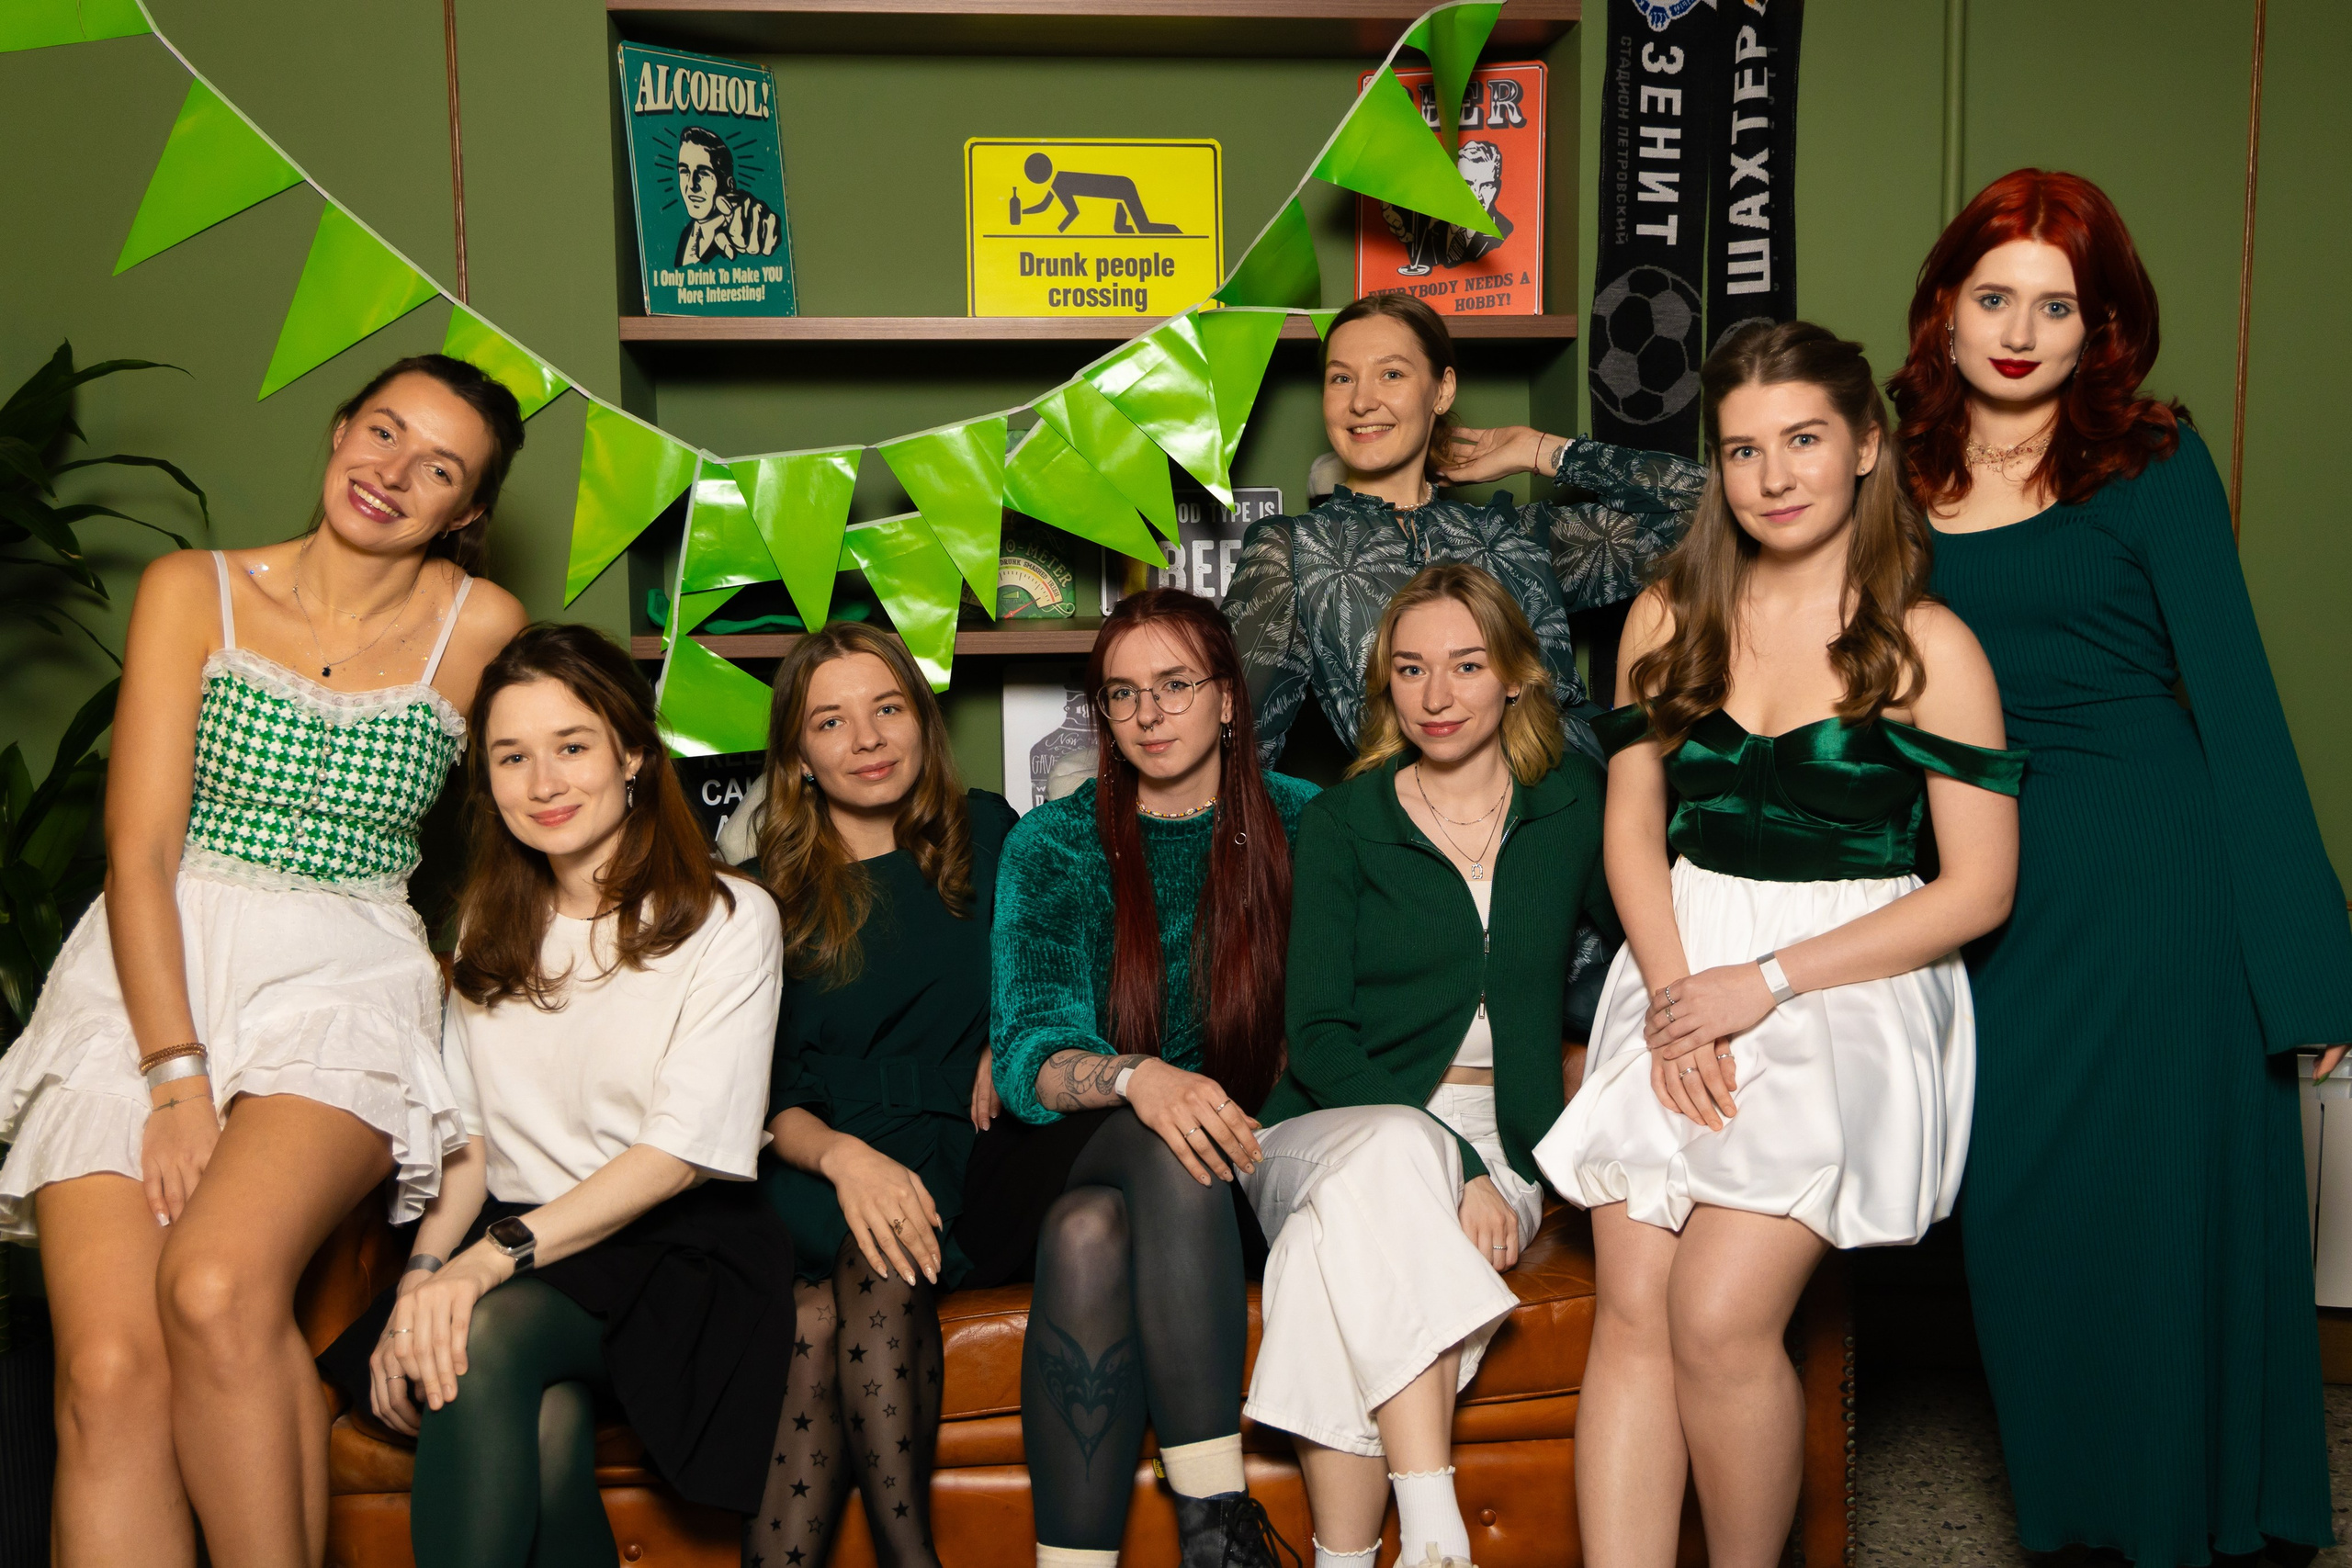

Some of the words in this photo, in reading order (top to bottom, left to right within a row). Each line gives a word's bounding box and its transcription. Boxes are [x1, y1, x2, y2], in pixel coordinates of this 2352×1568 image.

[635, 62, 769, 119] ALCOHOL!
[1616, 36, 1632, 119] СТАДИОН
[1402, 78, 1527, 132] EER
[1636, 42, 1685, 245] ЗЕНИТ
[1727, 25, 1771, 295] ШАХТЕР
[1615, 125, 1629, 245] ПЕТРОВСКИЙ
[653, 270, 658, 287] I
[661, 269, 684, 288] Only
[687, 268, 716, 286] Drink
[718, 268, 729, 284] To
[732, 267, 760, 284] Make
[762, 266, 783, 282] YOU
[1020, 252, 1088, 276] Drunk
[1096, 253, 1175, 282] people
[1464, 273, 1513, 291] NEEDS
[1520, 271, 1531, 285] A
[677, 288, 704, 305] More
[707, 285, 765, 302] Interesting!
[1048, 283, 1148, 312] crossing
[1454, 293, 1510, 312] HOBBY!
[1209, 502, 1250, 523] TYPE
[1259, 501, 1275, 516] IS
[1023, 561, 1047, 580] SMASHED
[1047, 580, 1059, 597] IRISH
